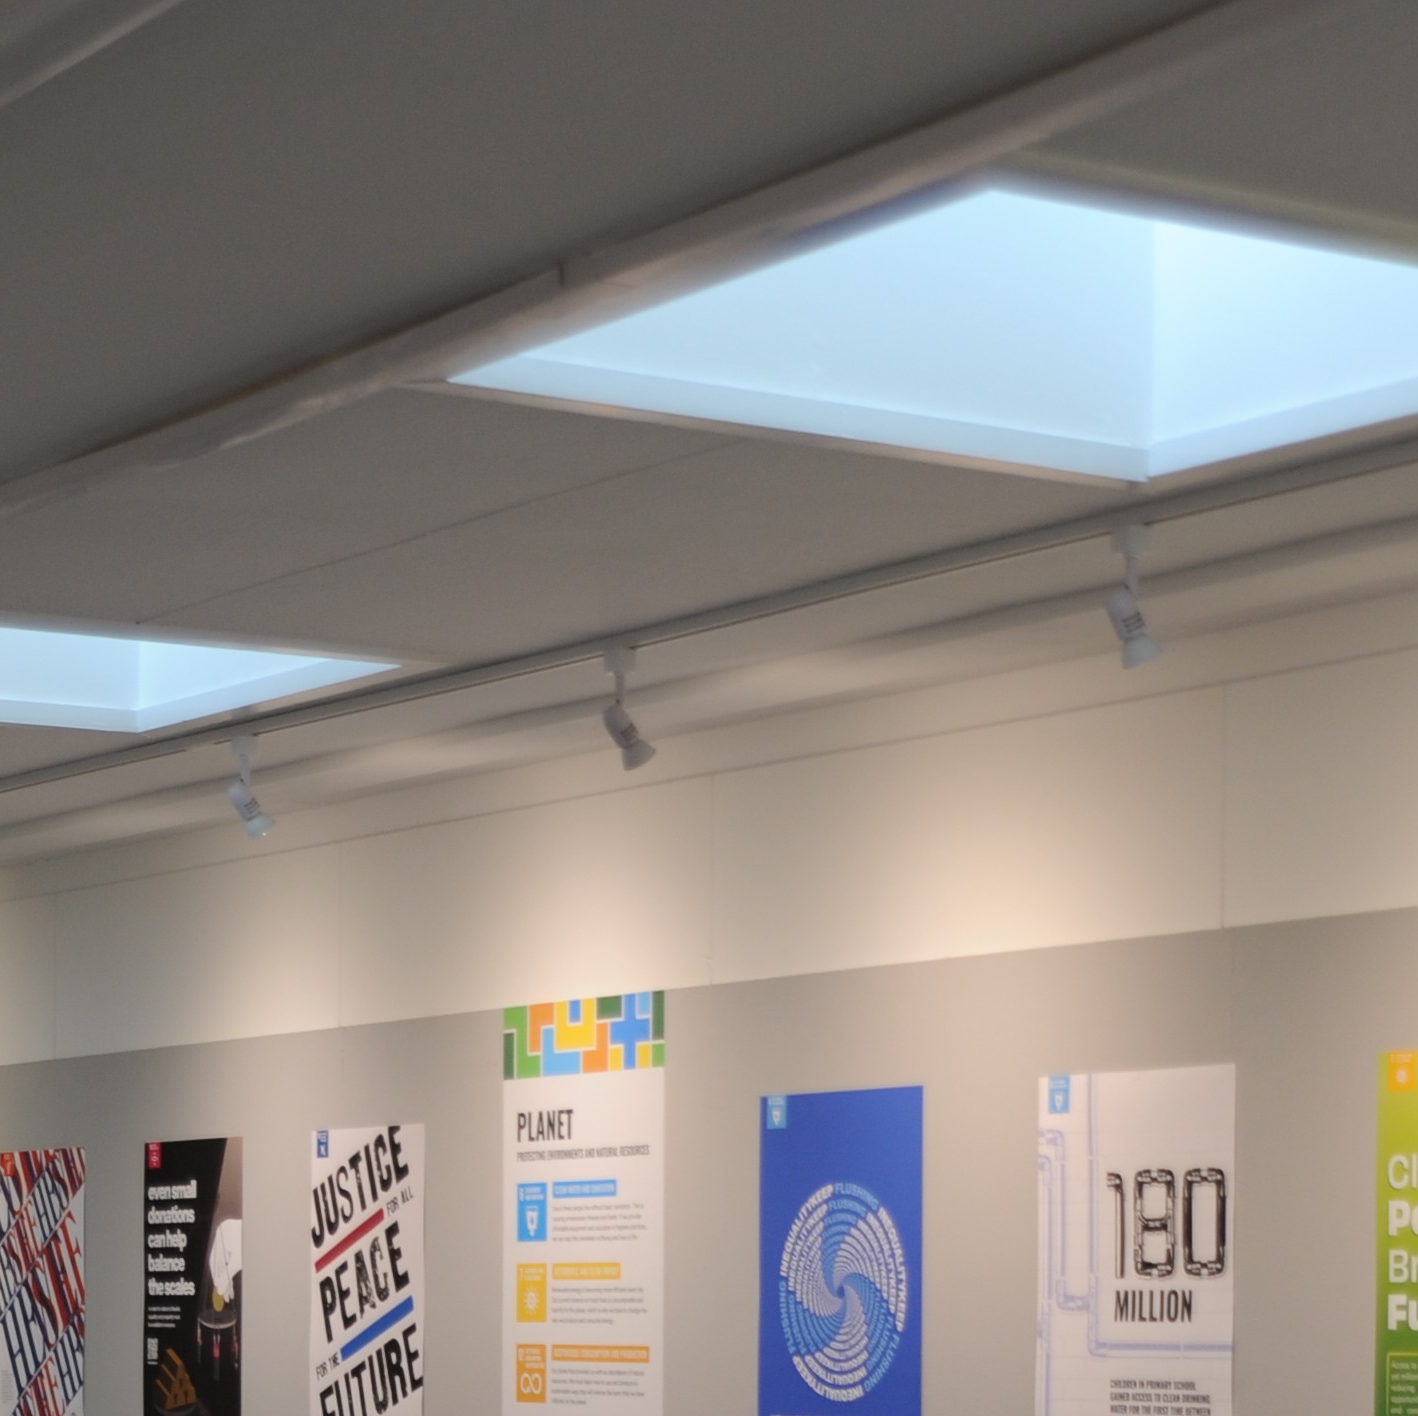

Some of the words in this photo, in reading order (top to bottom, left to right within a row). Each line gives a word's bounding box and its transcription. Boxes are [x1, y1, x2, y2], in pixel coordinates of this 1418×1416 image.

[516, 1109, 574, 1144] PLANET
[148, 1186, 171, 1200] even
[171, 1179, 197, 1199] small
[311, 1124, 410, 1249] JUSTICE
[835, 1183, 879, 1211] FLUSHING
[148, 1205, 195, 1224] donations
[386, 1193, 400, 1216] FOR
[401, 1187, 414, 1207] ALL
[1106, 1168, 1227, 1279] 180
[148, 1234, 166, 1248] can
[166, 1229, 187, 1252] help
[148, 1253, 185, 1272] balance
[148, 1277, 164, 1296] the
[164, 1277, 196, 1296] scales
[319, 1221, 411, 1344] PEACE
[1114, 1289, 1193, 1323] MILLION
[315, 1361, 328, 1380] FOR
[328, 1352, 340, 1370] THE
[864, 1333, 900, 1392] FLUSHING
